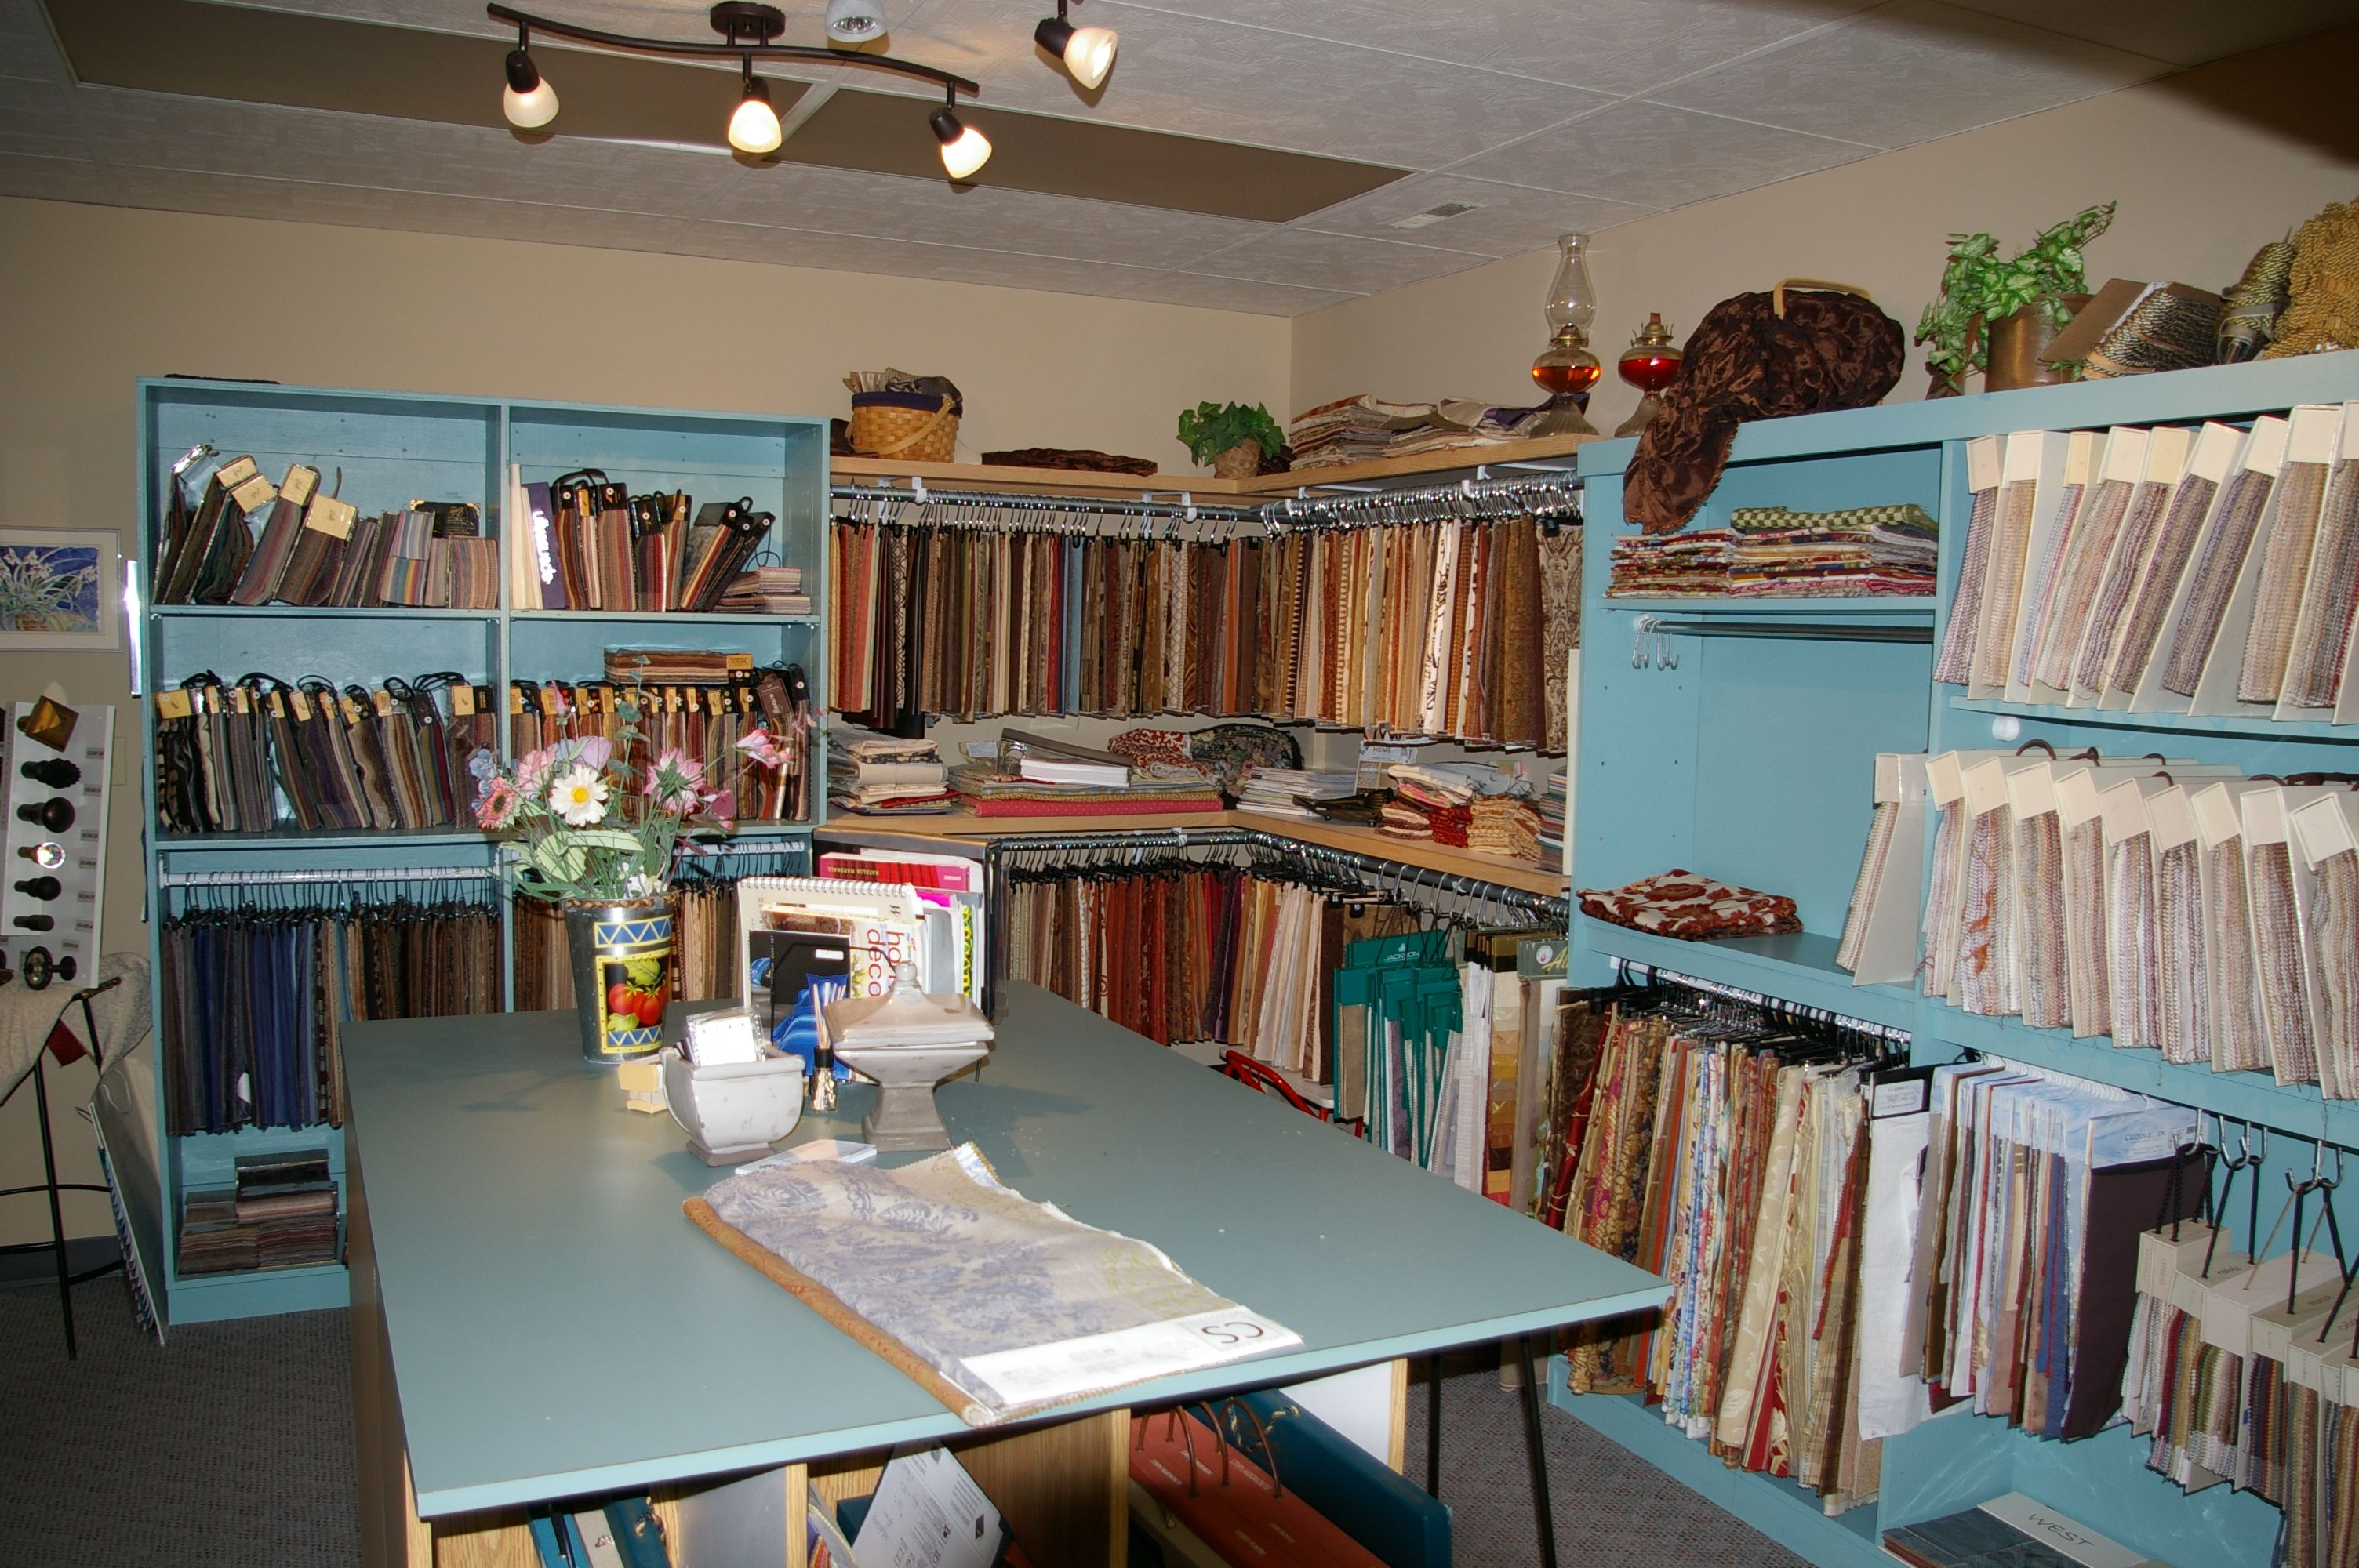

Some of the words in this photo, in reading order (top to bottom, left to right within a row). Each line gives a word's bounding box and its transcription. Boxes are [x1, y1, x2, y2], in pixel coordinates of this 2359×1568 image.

[856, 868, 879, 877] NATALIA
[867, 928, 886, 997] deco
[1541, 946, 1568, 972] Al
[2028, 1513, 2095, 1547] WEST
